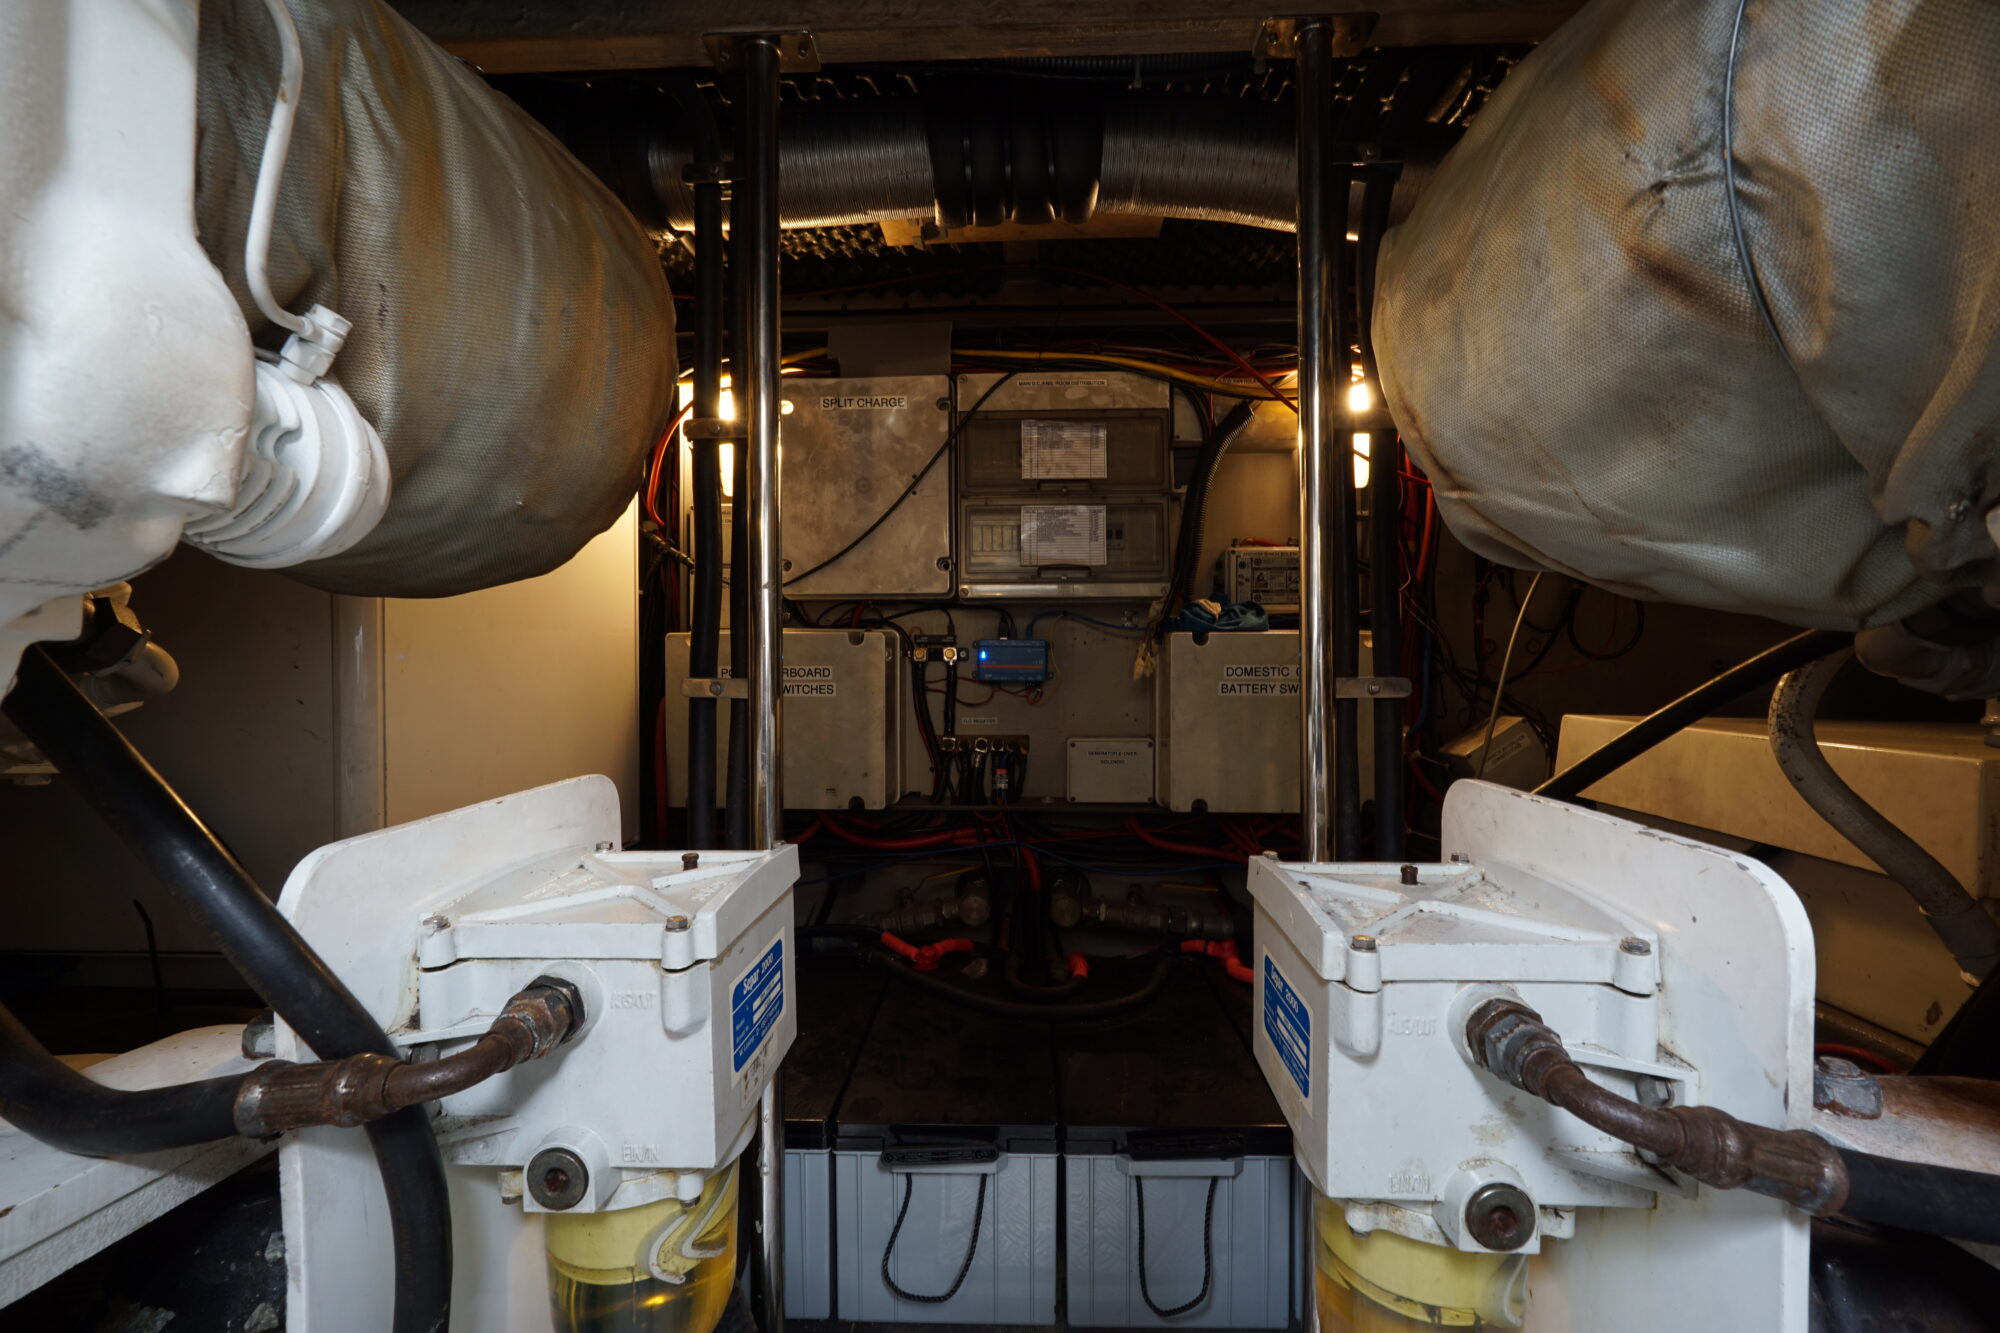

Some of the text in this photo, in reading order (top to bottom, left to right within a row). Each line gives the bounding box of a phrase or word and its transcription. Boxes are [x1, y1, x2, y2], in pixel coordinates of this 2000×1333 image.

[822, 397, 905, 408] SPLIT CHARGE
[1226, 666, 1290, 677] DOMESTIC
[782, 684, 834, 694] WITCHES
[1221, 684, 1276, 694] BATTERY
[743, 968, 760, 996] Separ
[761, 952, 774, 974] 2000
[1286, 988, 1298, 1013] 2000
